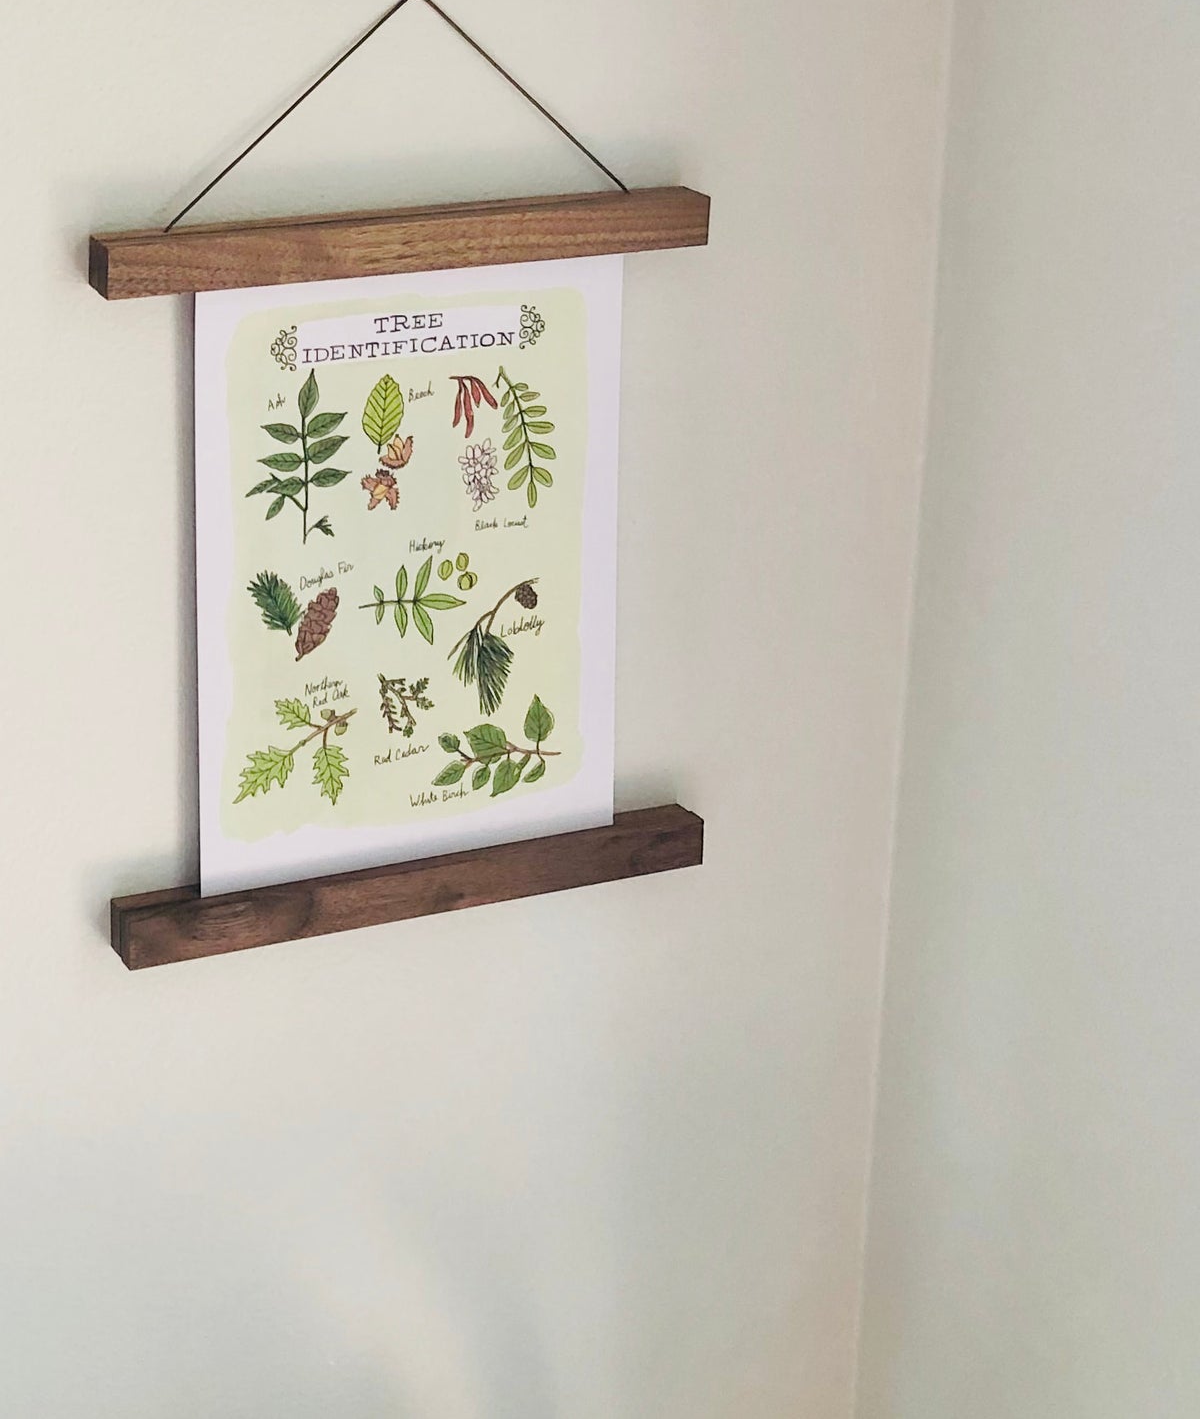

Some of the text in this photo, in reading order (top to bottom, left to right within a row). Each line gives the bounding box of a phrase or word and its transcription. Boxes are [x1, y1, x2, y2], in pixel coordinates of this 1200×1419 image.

[374, 313, 444, 334] TREE
[301, 332, 515, 364] IDENTIFICATION
[408, 381, 434, 403] Beech
[299, 561, 354, 591] Douglas Fir
[312, 693, 329, 708] Red
[374, 743, 430, 765] Red Cedar
[409, 783, 469, 807] White Birch
